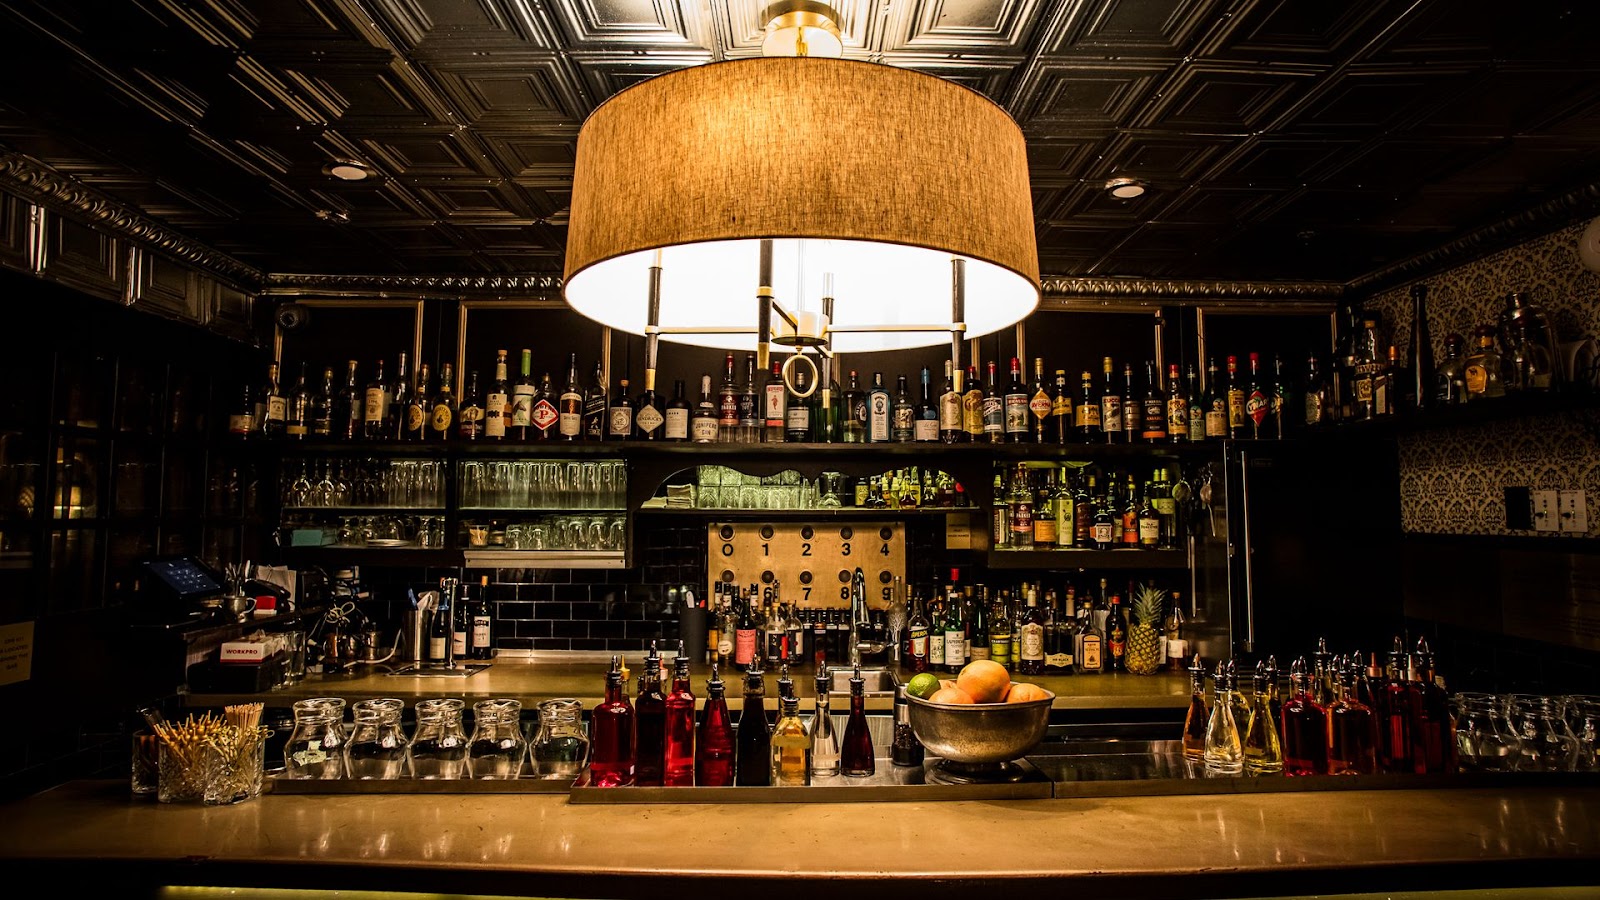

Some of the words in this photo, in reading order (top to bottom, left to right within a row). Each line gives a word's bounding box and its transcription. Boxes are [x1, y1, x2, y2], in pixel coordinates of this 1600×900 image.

[540, 410, 549, 420] P
[722, 544, 734, 556] 0
[762, 544, 769, 556] 1
[802, 544, 812, 556] 2
[841, 544, 851, 556] 3
[880, 544, 890, 556] 4
[763, 587, 773, 600] 6
[802, 588, 812, 600] 7
[840, 587, 850, 600] 8
[882, 587, 891, 600] 9
